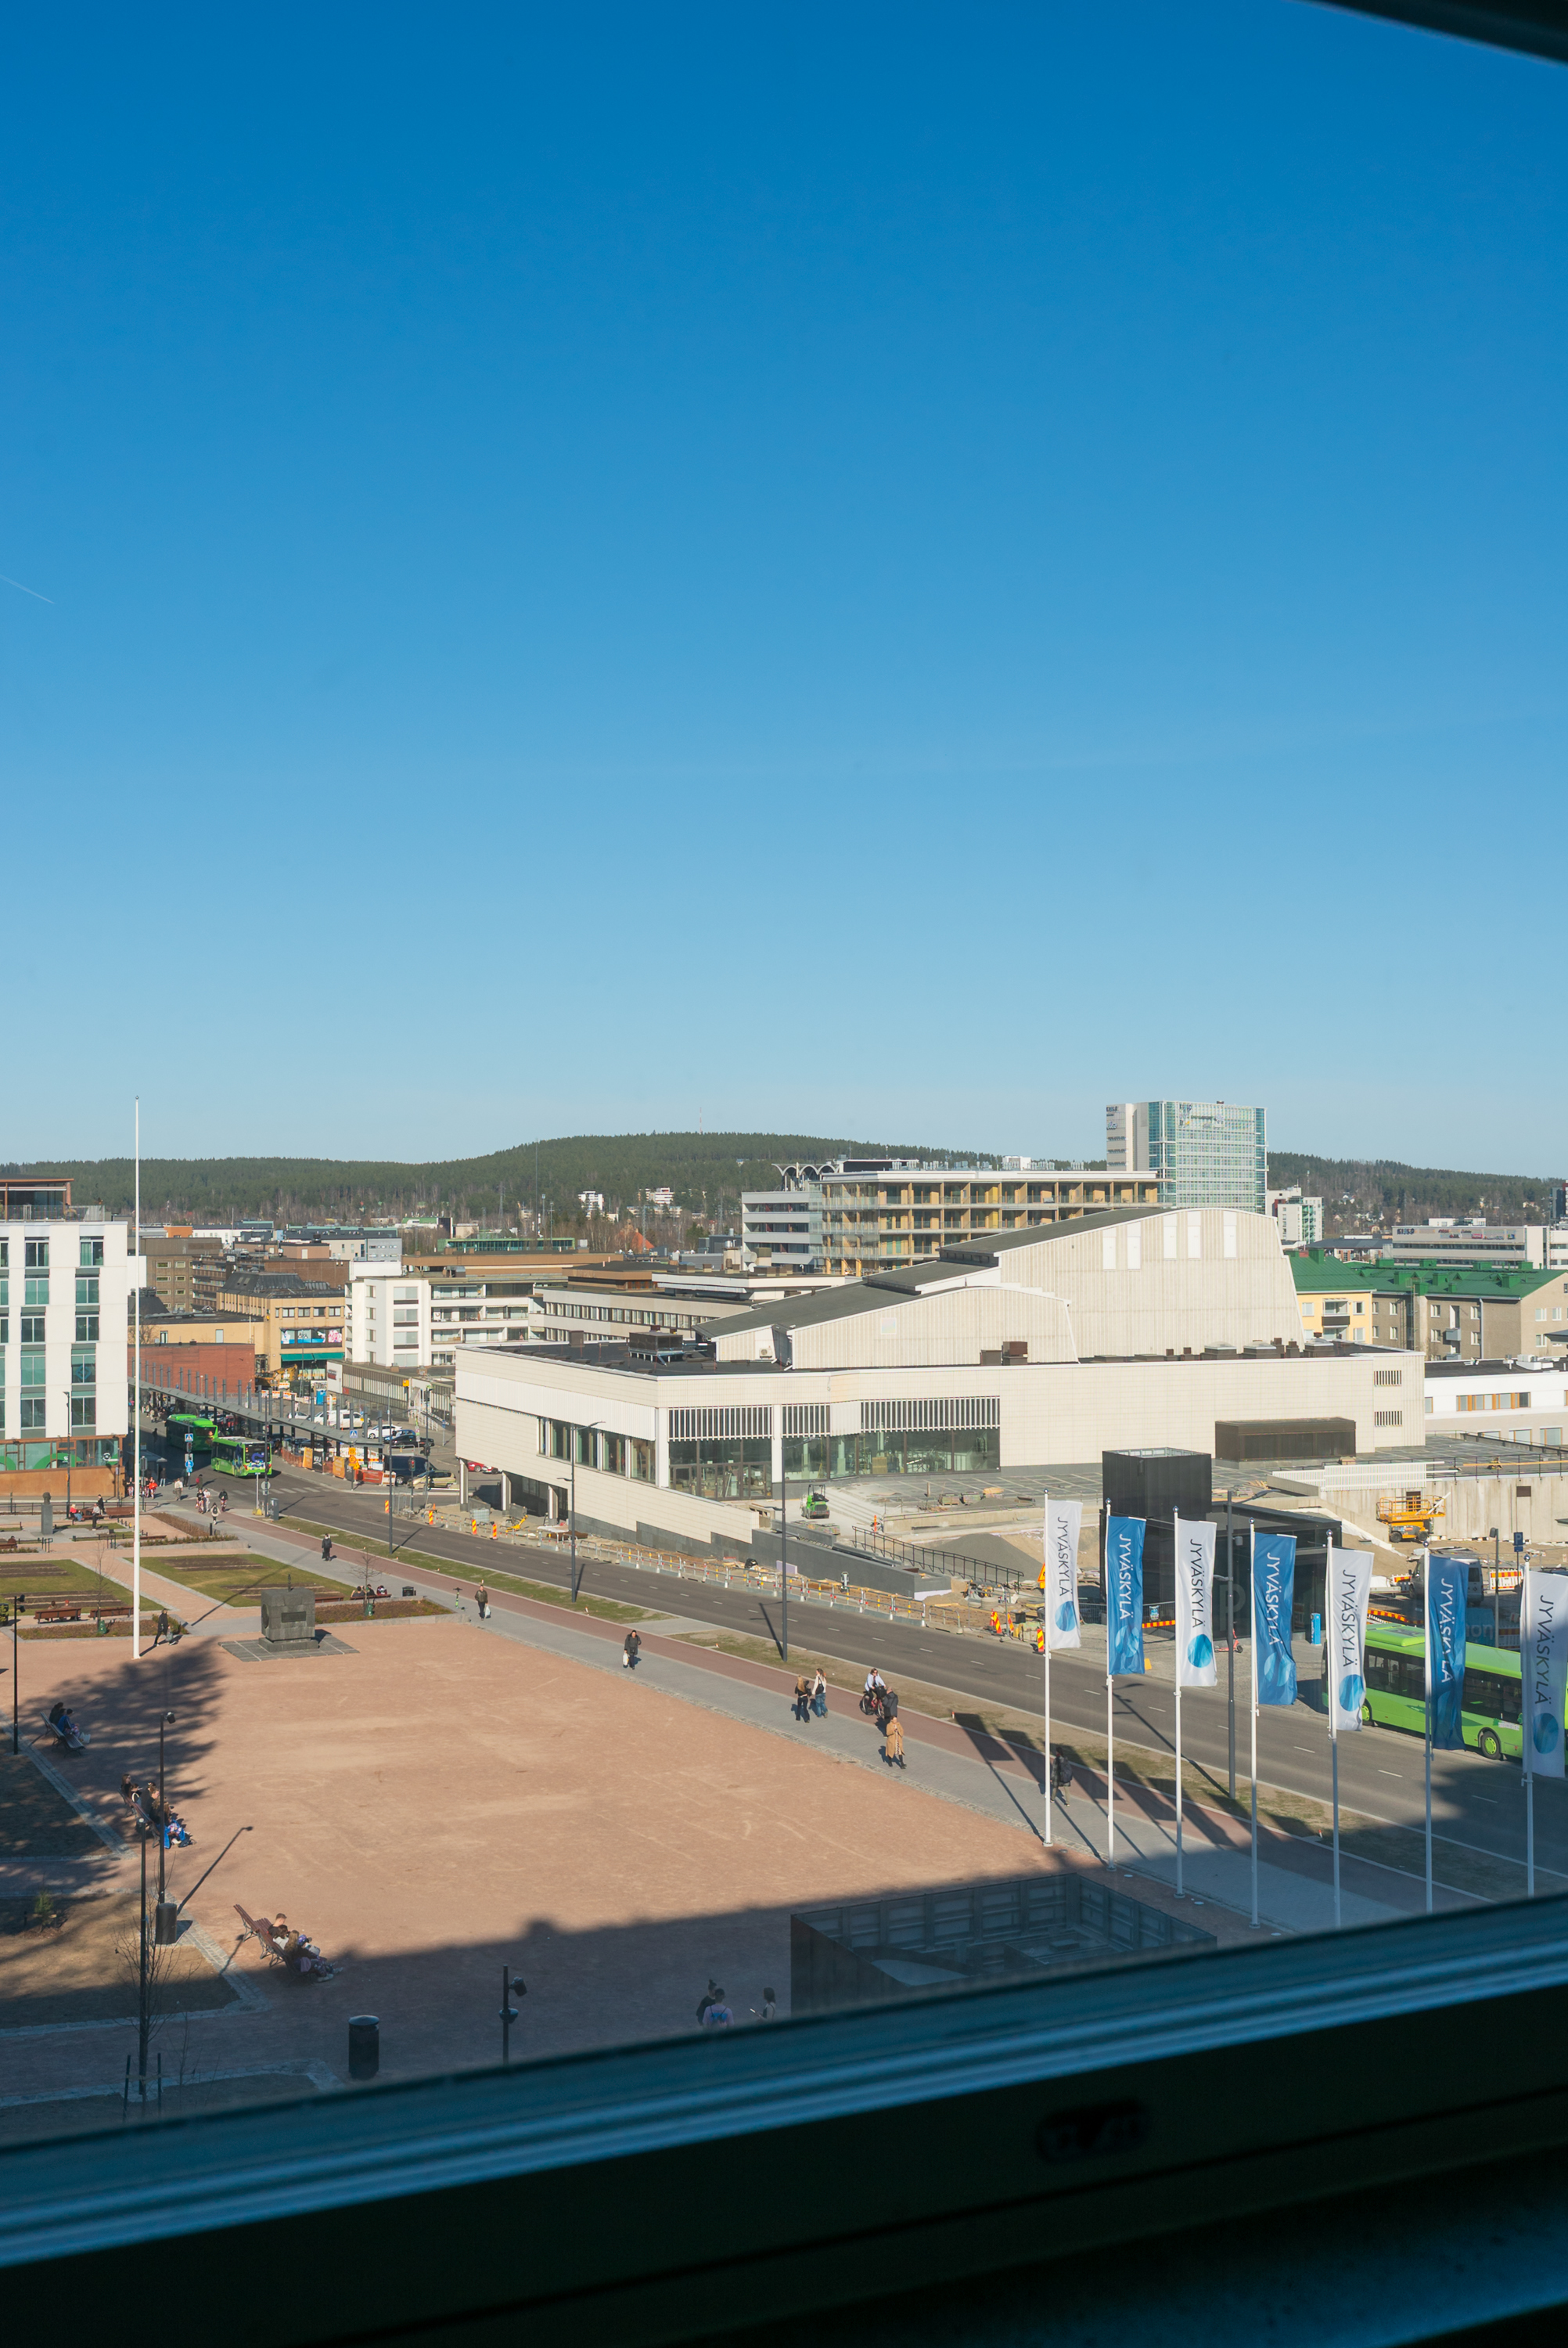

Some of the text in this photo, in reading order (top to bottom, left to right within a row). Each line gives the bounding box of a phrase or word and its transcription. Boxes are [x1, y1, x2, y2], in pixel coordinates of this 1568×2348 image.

[1057, 1517, 1073, 1597] JYVÄSKYLÄ
[1119, 1533, 1134, 1620] JYVÄSKYLÄ
[1516, 1533, 1522, 1545] P
[1190, 1539, 1206, 1628] JYVÄSKYLÄ
[1219, 1584, 1246, 1632] P
[1265, 1552, 1283, 1645] JYVÄSKYLÄ
[1341, 1569, 1358, 1667] JYVÄSKYLÄ
[1534, 1595, 1555, 1705] JYVÄSKYLÄ
